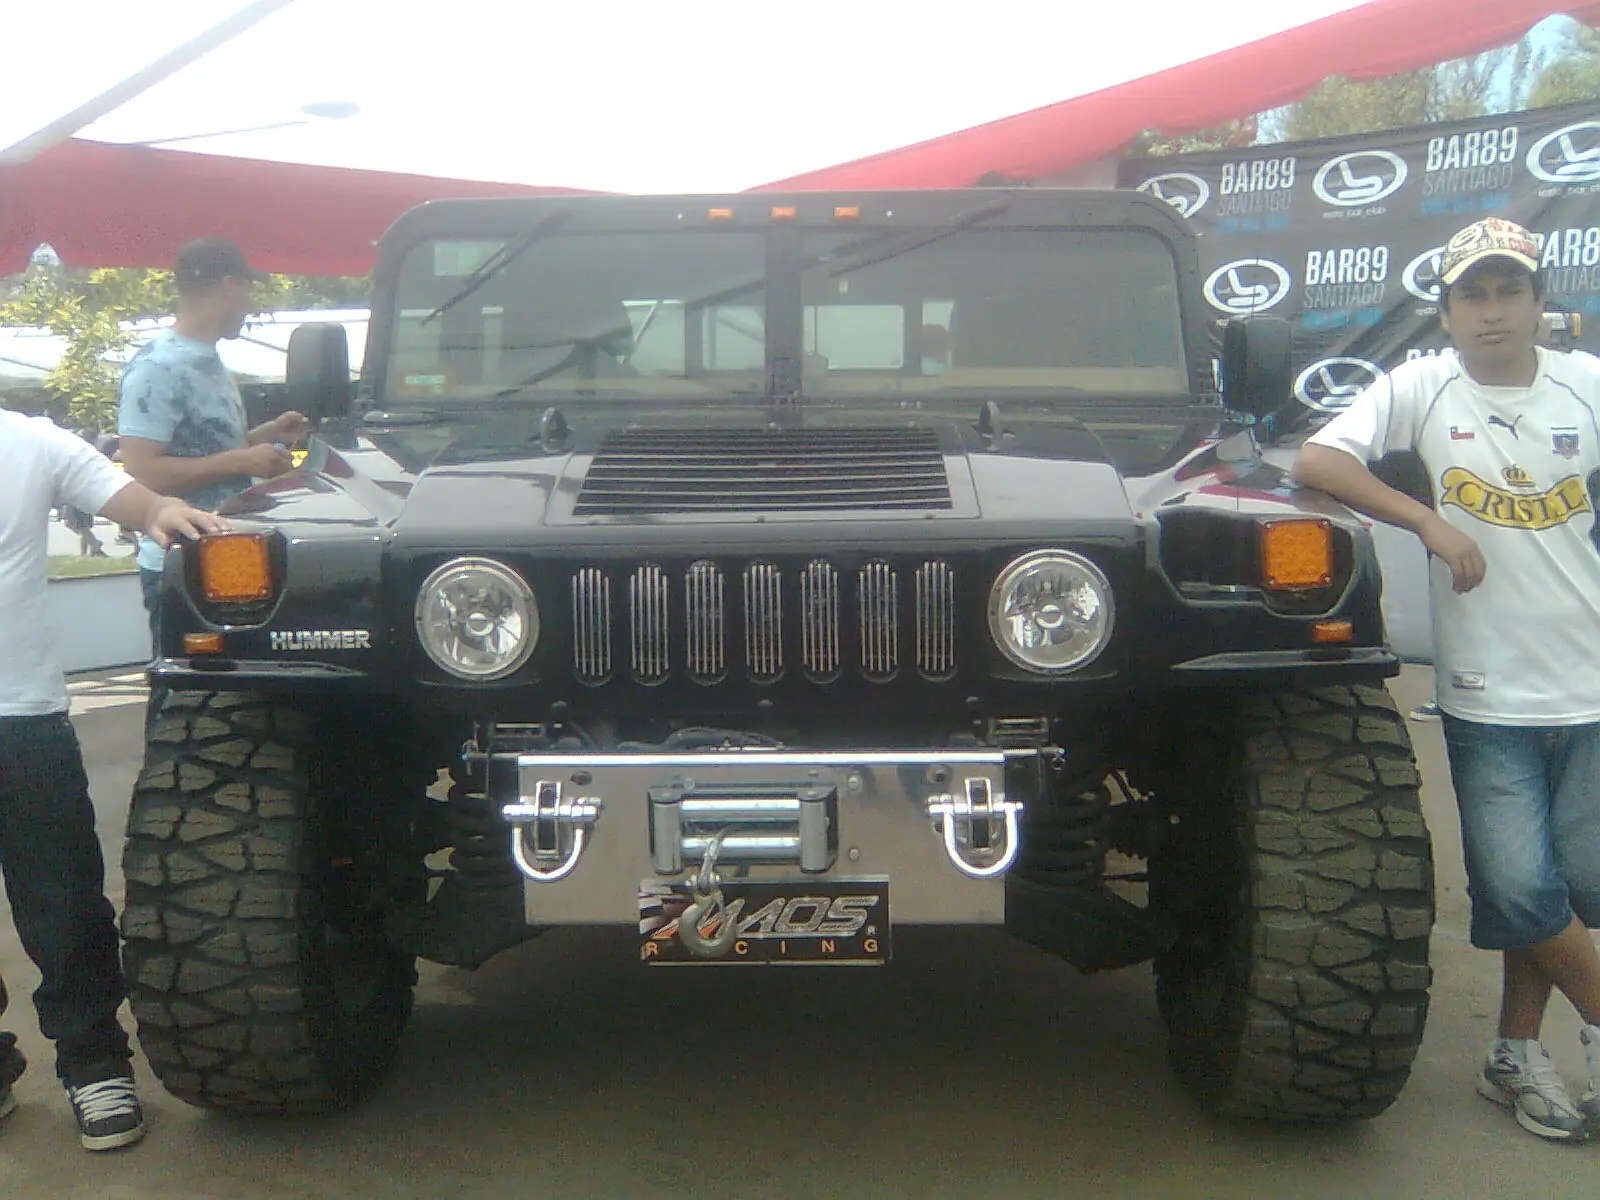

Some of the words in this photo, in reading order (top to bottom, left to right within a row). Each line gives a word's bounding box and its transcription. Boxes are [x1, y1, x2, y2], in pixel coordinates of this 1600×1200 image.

[1425, 127, 1518, 172] BAR89
[1220, 157, 1295, 195] BAR89
[1422, 164, 1513, 196] SANTIAGO
[1216, 191, 1291, 216] SANTIAGO
[1305, 245, 1389, 285] BAR89
[1303, 283, 1385, 309] SANTIAGO
[1456, 481, 1588, 522] CRISTL
[270, 629, 372, 650] HUMMER
[645, 939, 878, 957] RCING
